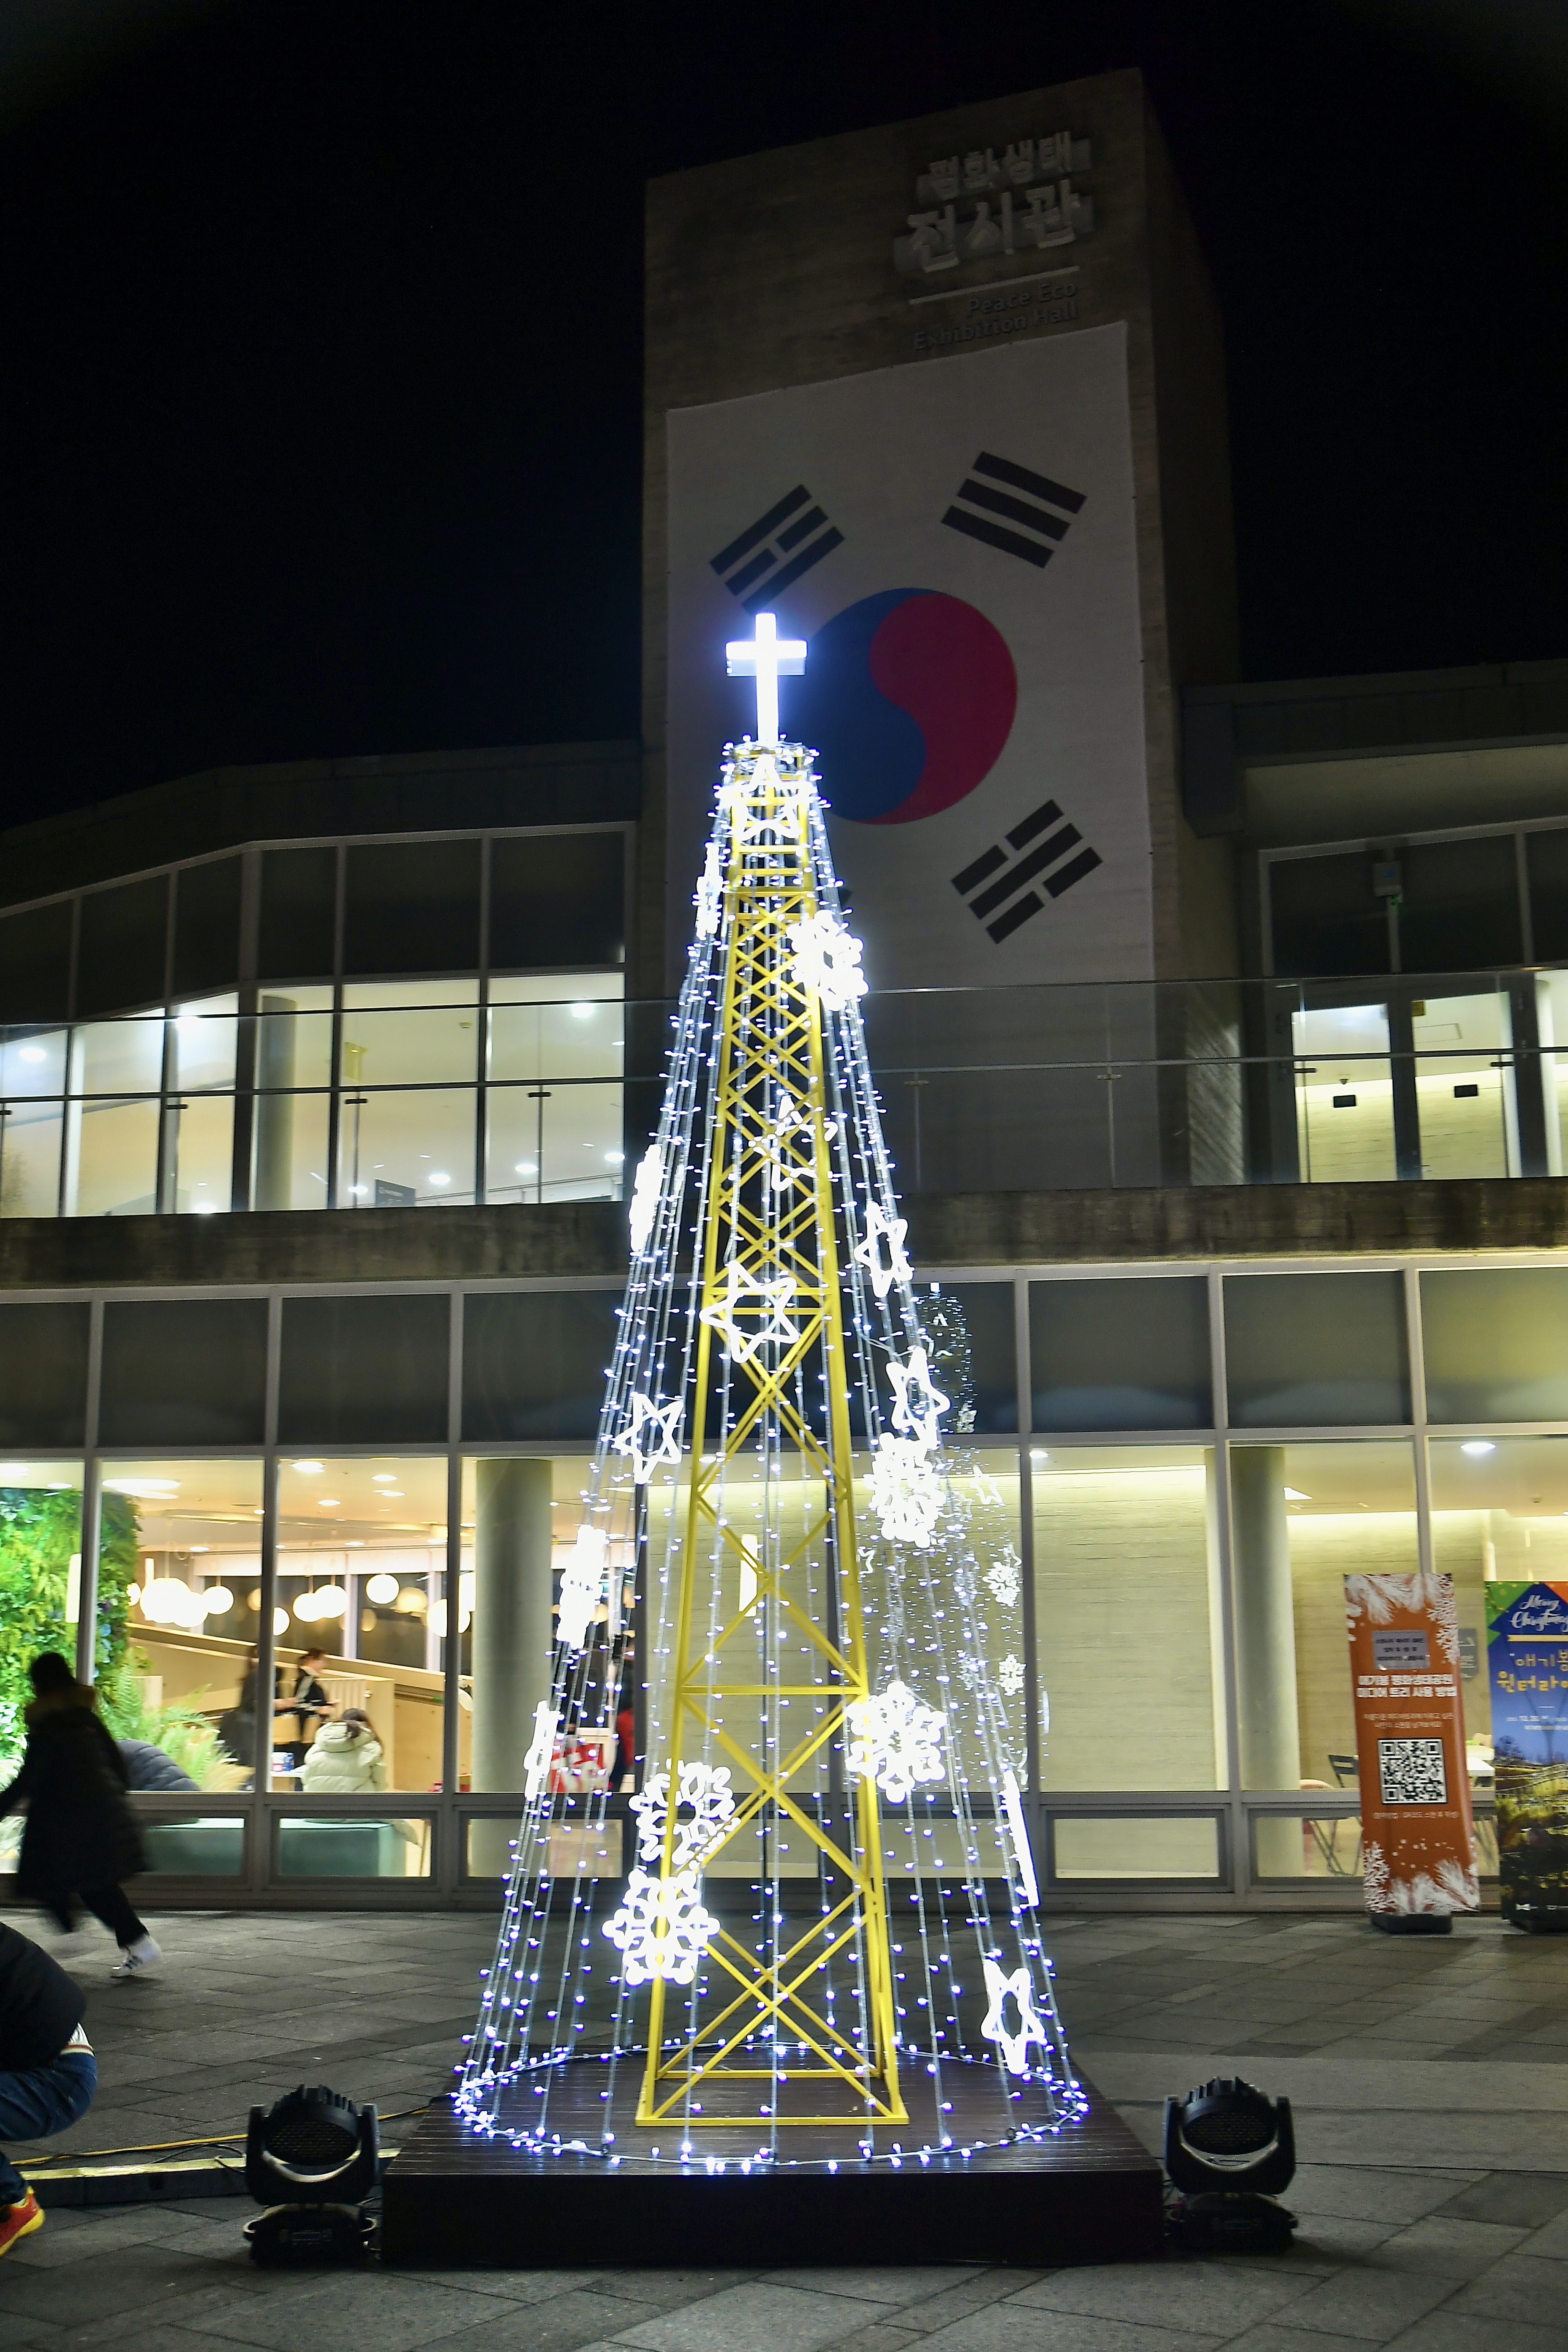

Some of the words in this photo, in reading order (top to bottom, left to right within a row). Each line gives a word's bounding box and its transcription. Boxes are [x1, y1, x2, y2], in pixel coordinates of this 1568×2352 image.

[928, 131, 1072, 200] 평화생태
[907, 179, 1080, 272] 전시관
[915, 315, 1028, 351] Exhibition
[1035, 302, 1078, 325] Hall
[968, 290, 1032, 317] Peace
[1039, 281, 1078, 302] Eco
